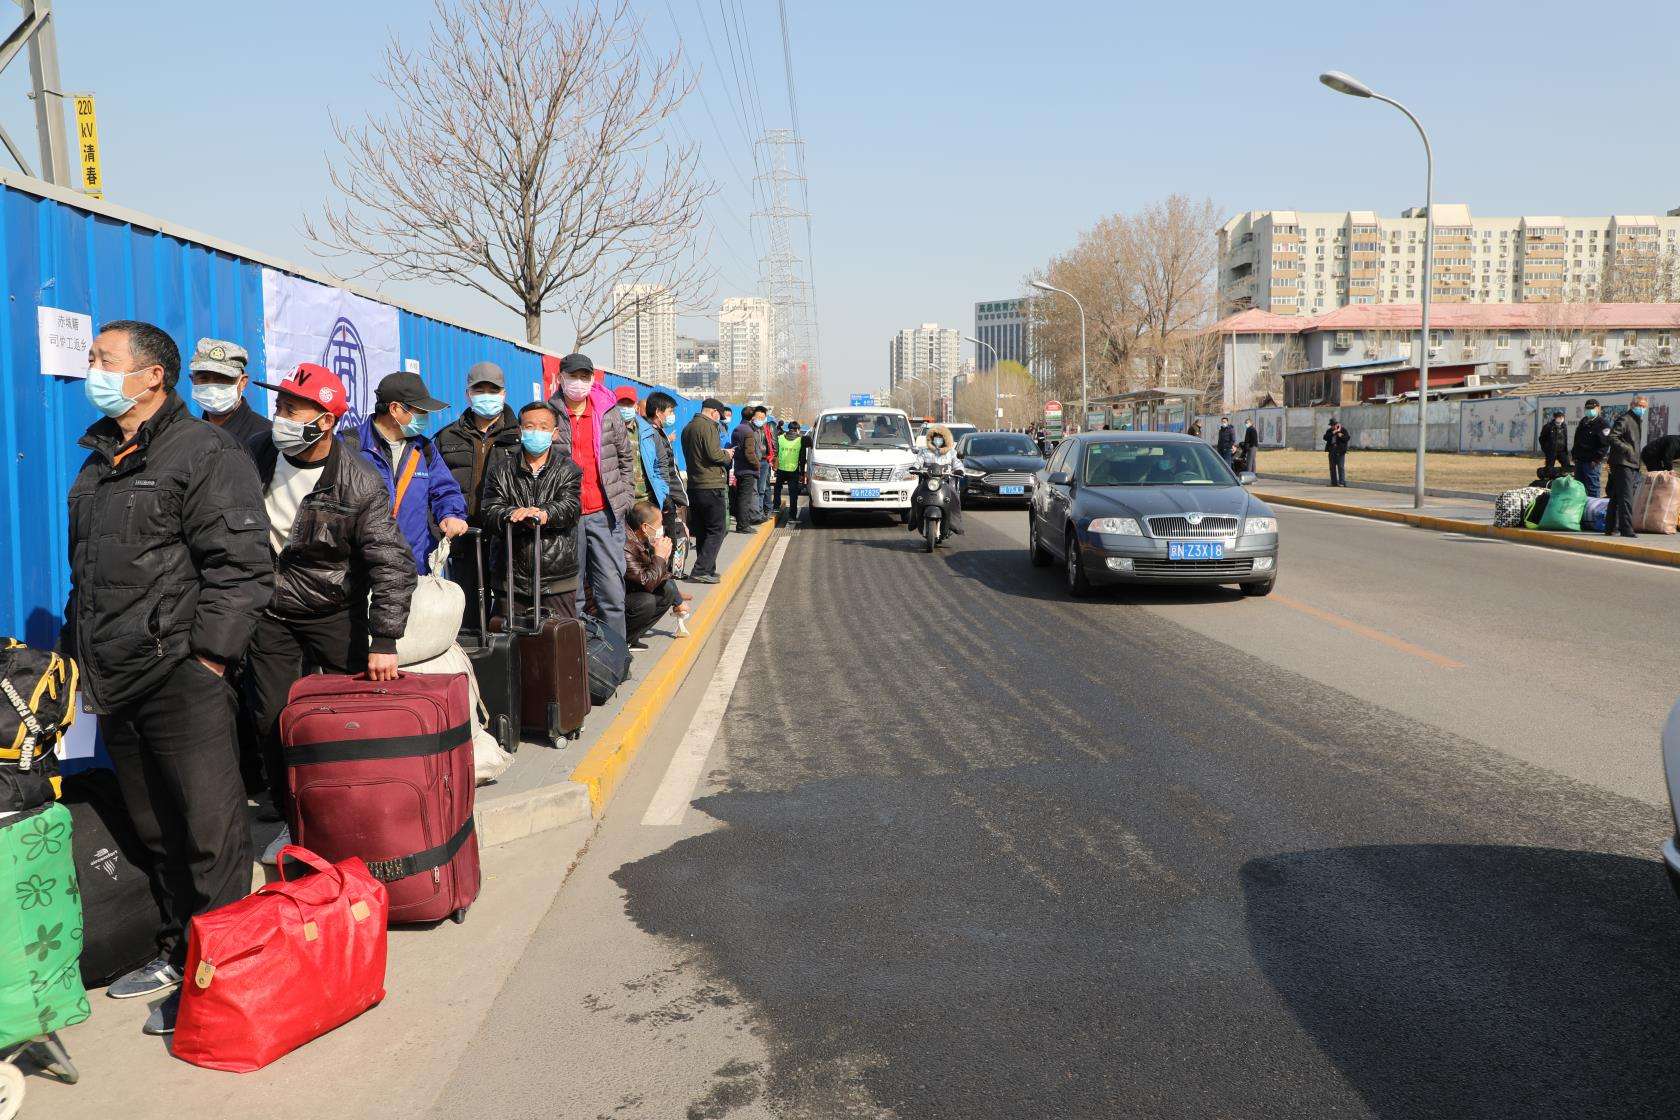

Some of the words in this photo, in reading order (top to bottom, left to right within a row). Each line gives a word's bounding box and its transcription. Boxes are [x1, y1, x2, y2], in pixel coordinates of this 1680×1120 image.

[77, 100, 93, 115] 220
[80, 122, 93, 137] kV
[0, 678, 31, 717] FASHION
